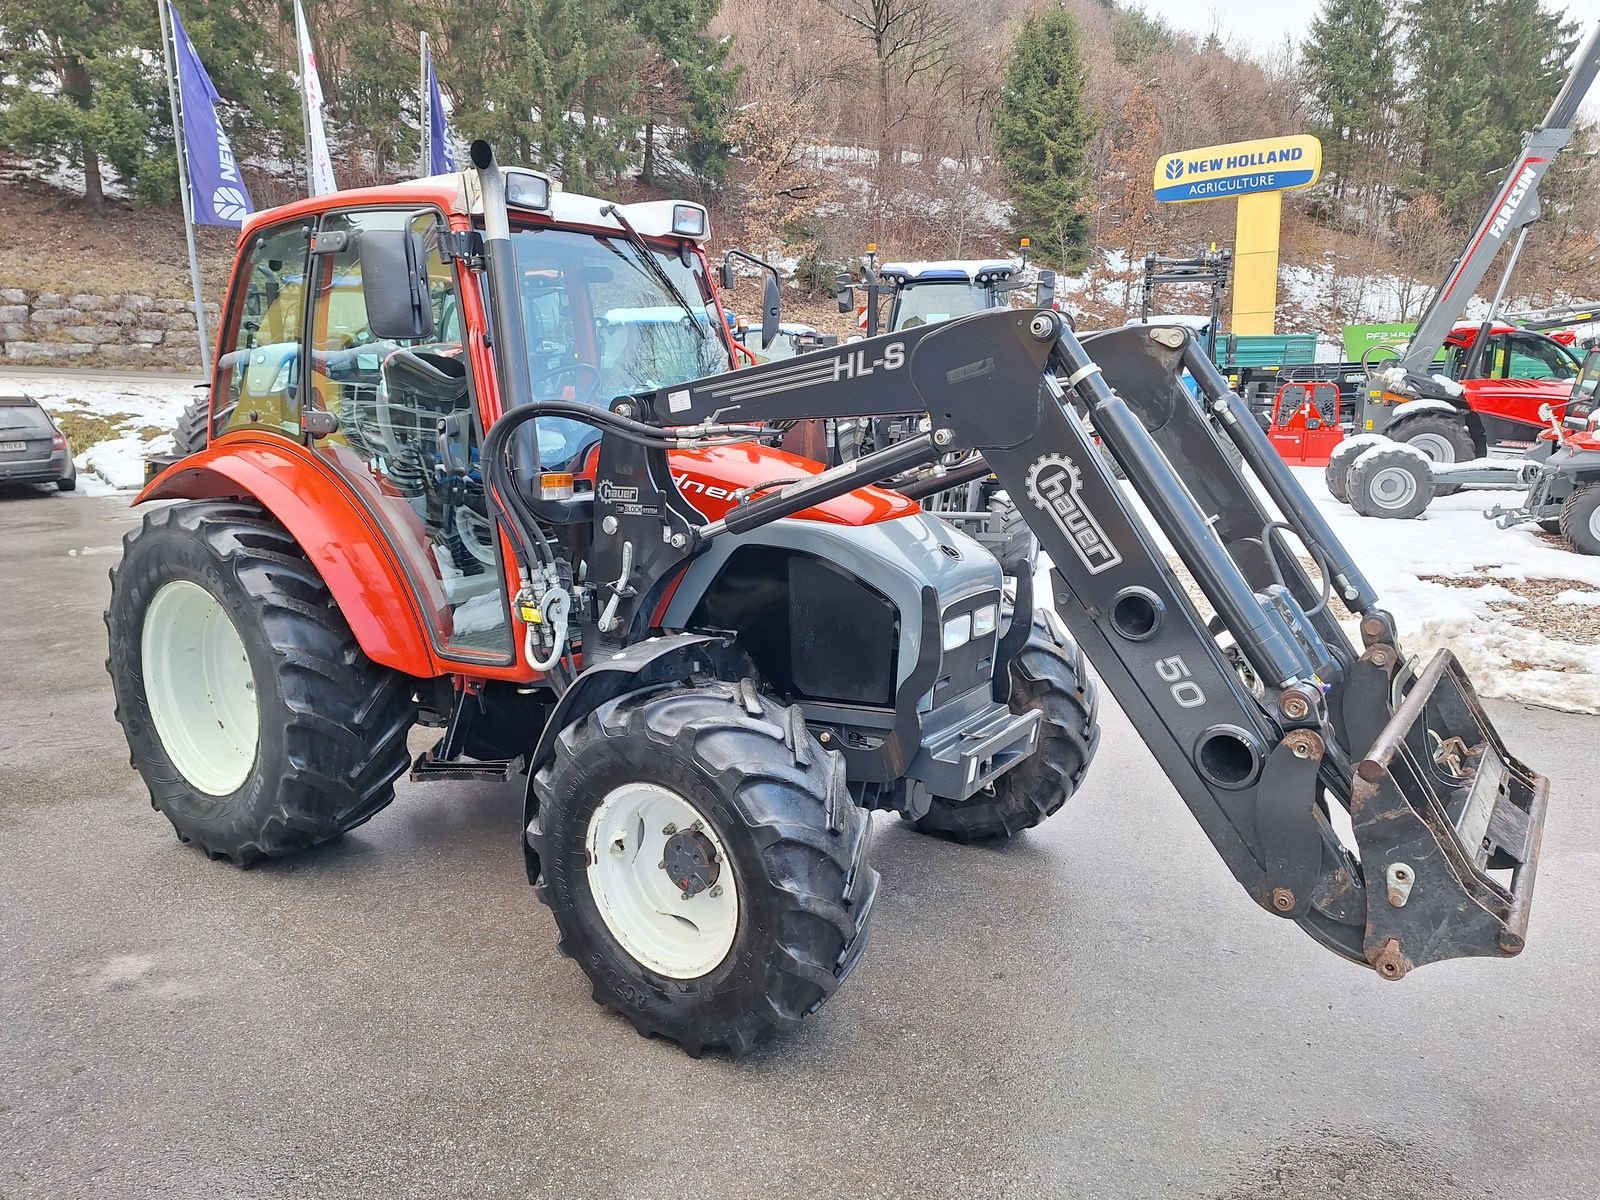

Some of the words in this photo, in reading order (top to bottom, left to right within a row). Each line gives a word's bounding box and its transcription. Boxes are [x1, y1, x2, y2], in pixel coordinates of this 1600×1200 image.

[1188, 158, 1224, 174] NEW
[1226, 147, 1303, 169] HOLLAND
[1189, 174, 1275, 196] AGRICULTURE
[1489, 166, 1537, 239] FARESIN
[1366, 332, 1389, 340] PF2
[832, 342, 906, 382] HL-S
[604, 485, 635, 499] hauer
[1039, 470, 1112, 560] hauer
[1154, 654, 1207, 709] 50
